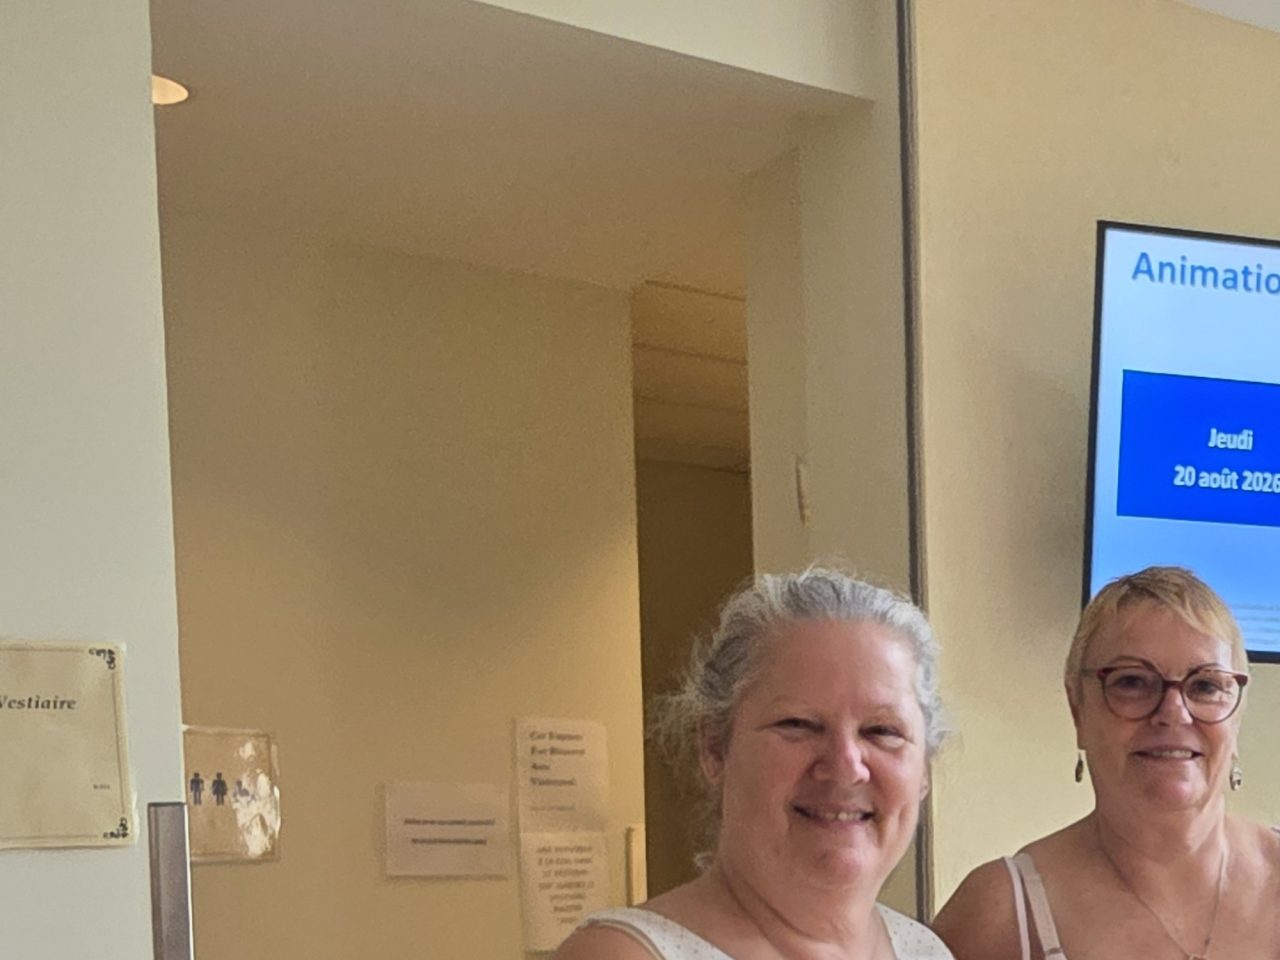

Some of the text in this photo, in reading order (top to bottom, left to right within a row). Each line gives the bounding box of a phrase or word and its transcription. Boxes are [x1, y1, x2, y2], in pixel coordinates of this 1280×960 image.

[1208, 428, 1253, 450] Jeudi
[1173, 464, 1196, 486] 20
[1198, 467, 1239, 489] août
